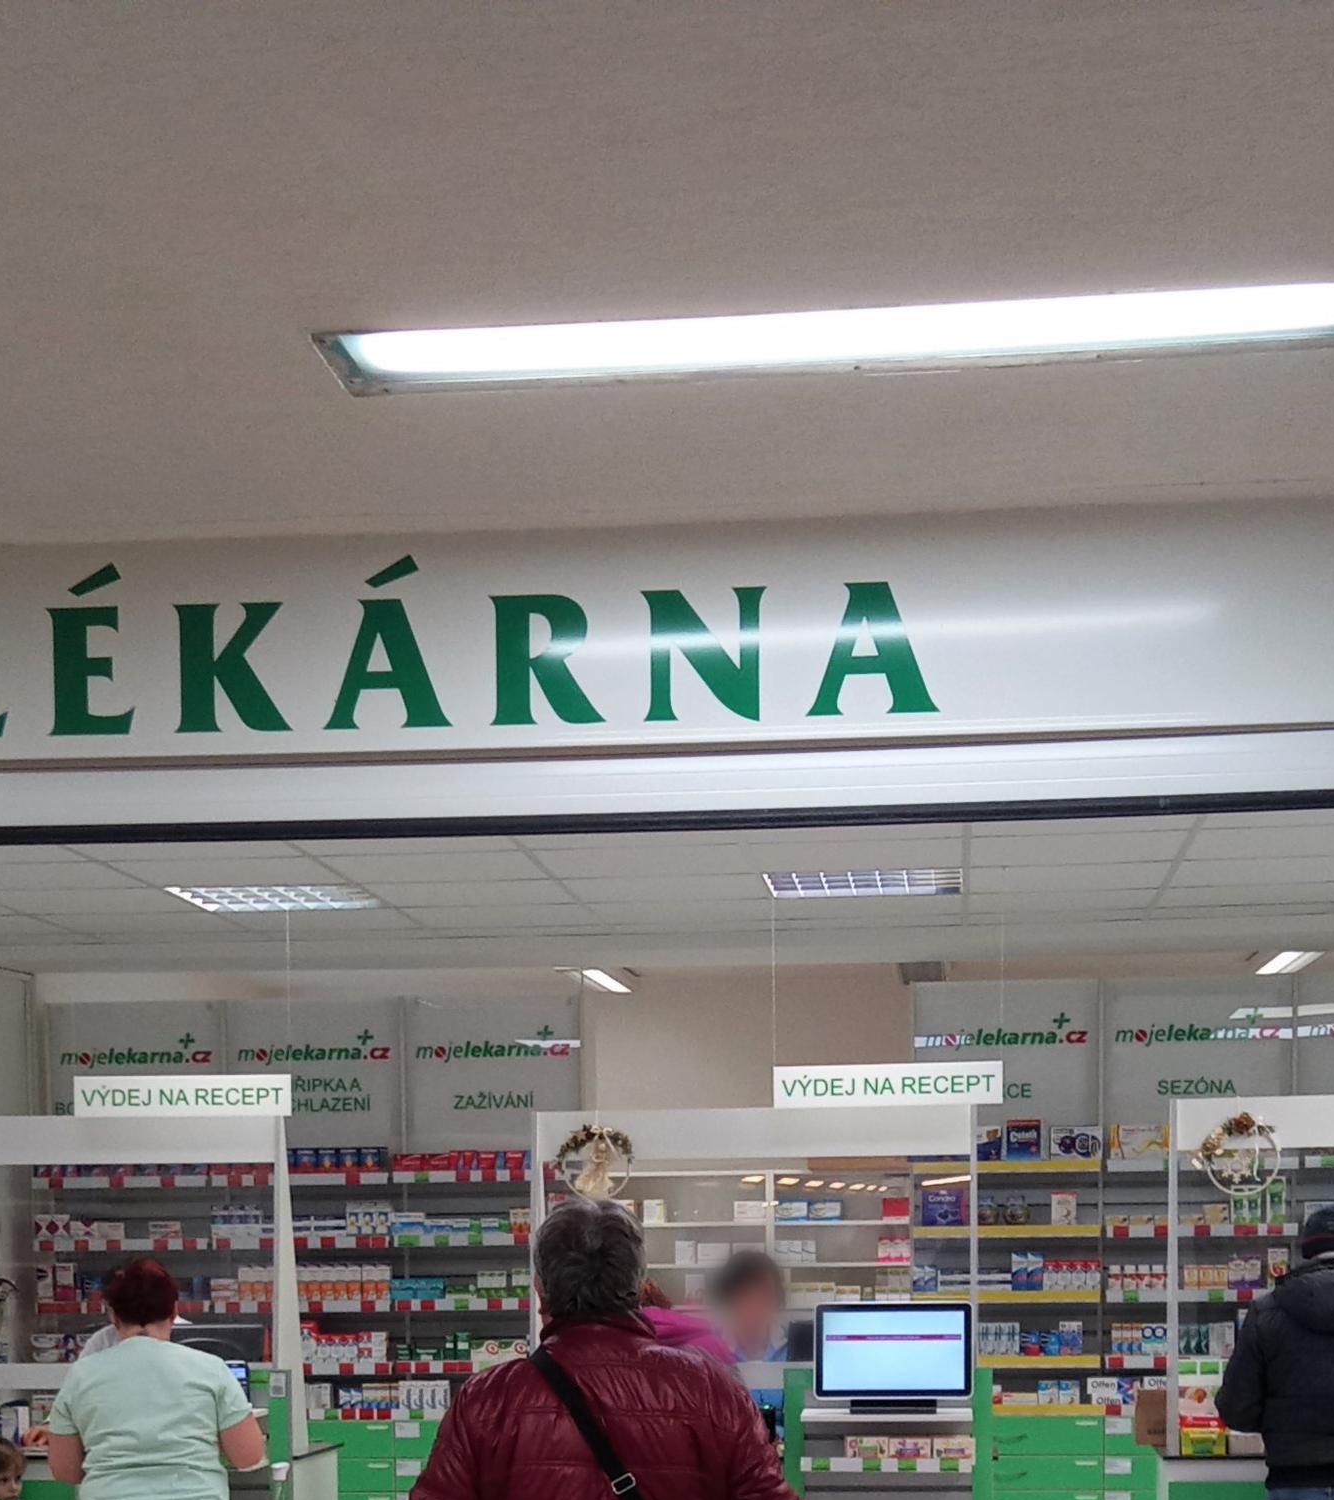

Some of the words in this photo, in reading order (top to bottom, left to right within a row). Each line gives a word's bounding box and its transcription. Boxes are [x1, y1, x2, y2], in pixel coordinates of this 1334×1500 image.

[293, 1075, 347, 1093] ŘIPKA
[782, 1075, 855, 1097] VÝDEJ
[864, 1077, 895, 1096] NA
[902, 1074, 996, 1095] RECEPT
[1157, 1076, 1236, 1095] SEZÓNA
[81, 1085, 152, 1107] VÝDEJ
[159, 1088, 189, 1106] NA
[195, 1087, 284, 1106] RECEPT
[292, 1094, 371, 1113] HLAZENÍ
[453, 1091, 534, 1110] ZAŽÍVÁNÍ
